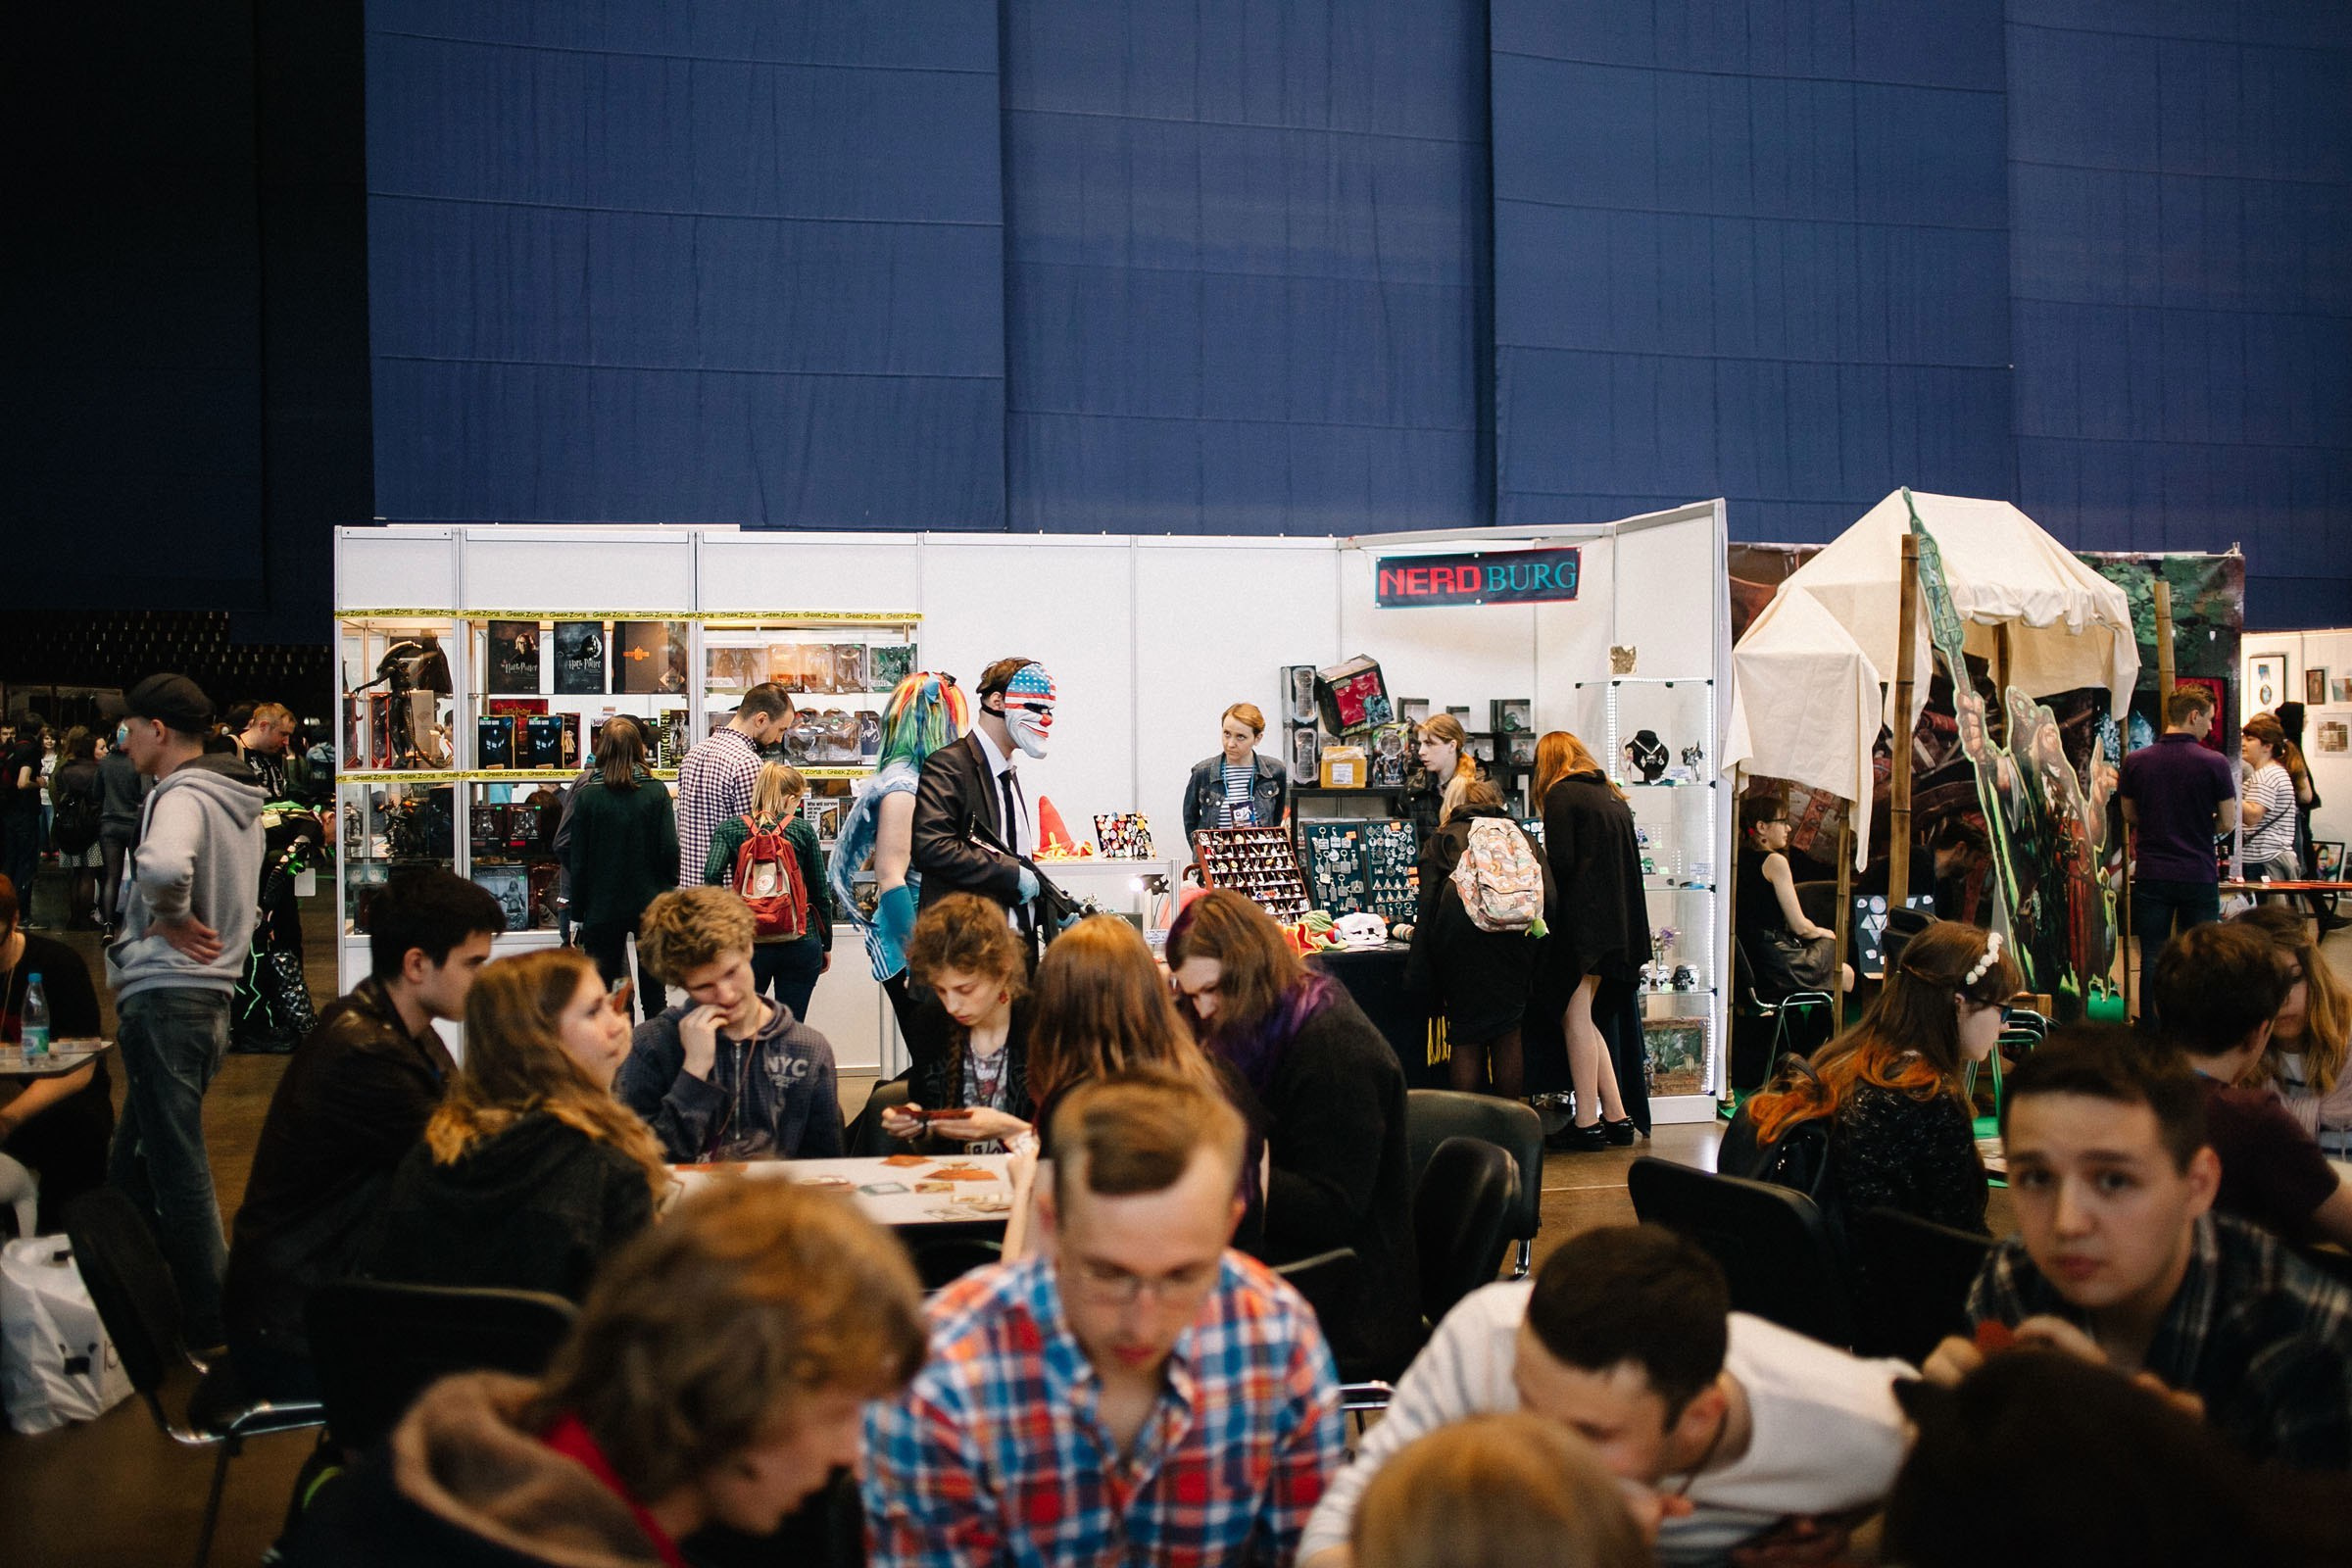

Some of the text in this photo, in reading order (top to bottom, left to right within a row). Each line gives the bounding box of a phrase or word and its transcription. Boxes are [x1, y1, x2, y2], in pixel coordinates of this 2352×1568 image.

[1379, 562, 1577, 596] NERD BURG
[764, 1055, 808, 1077] NYC
